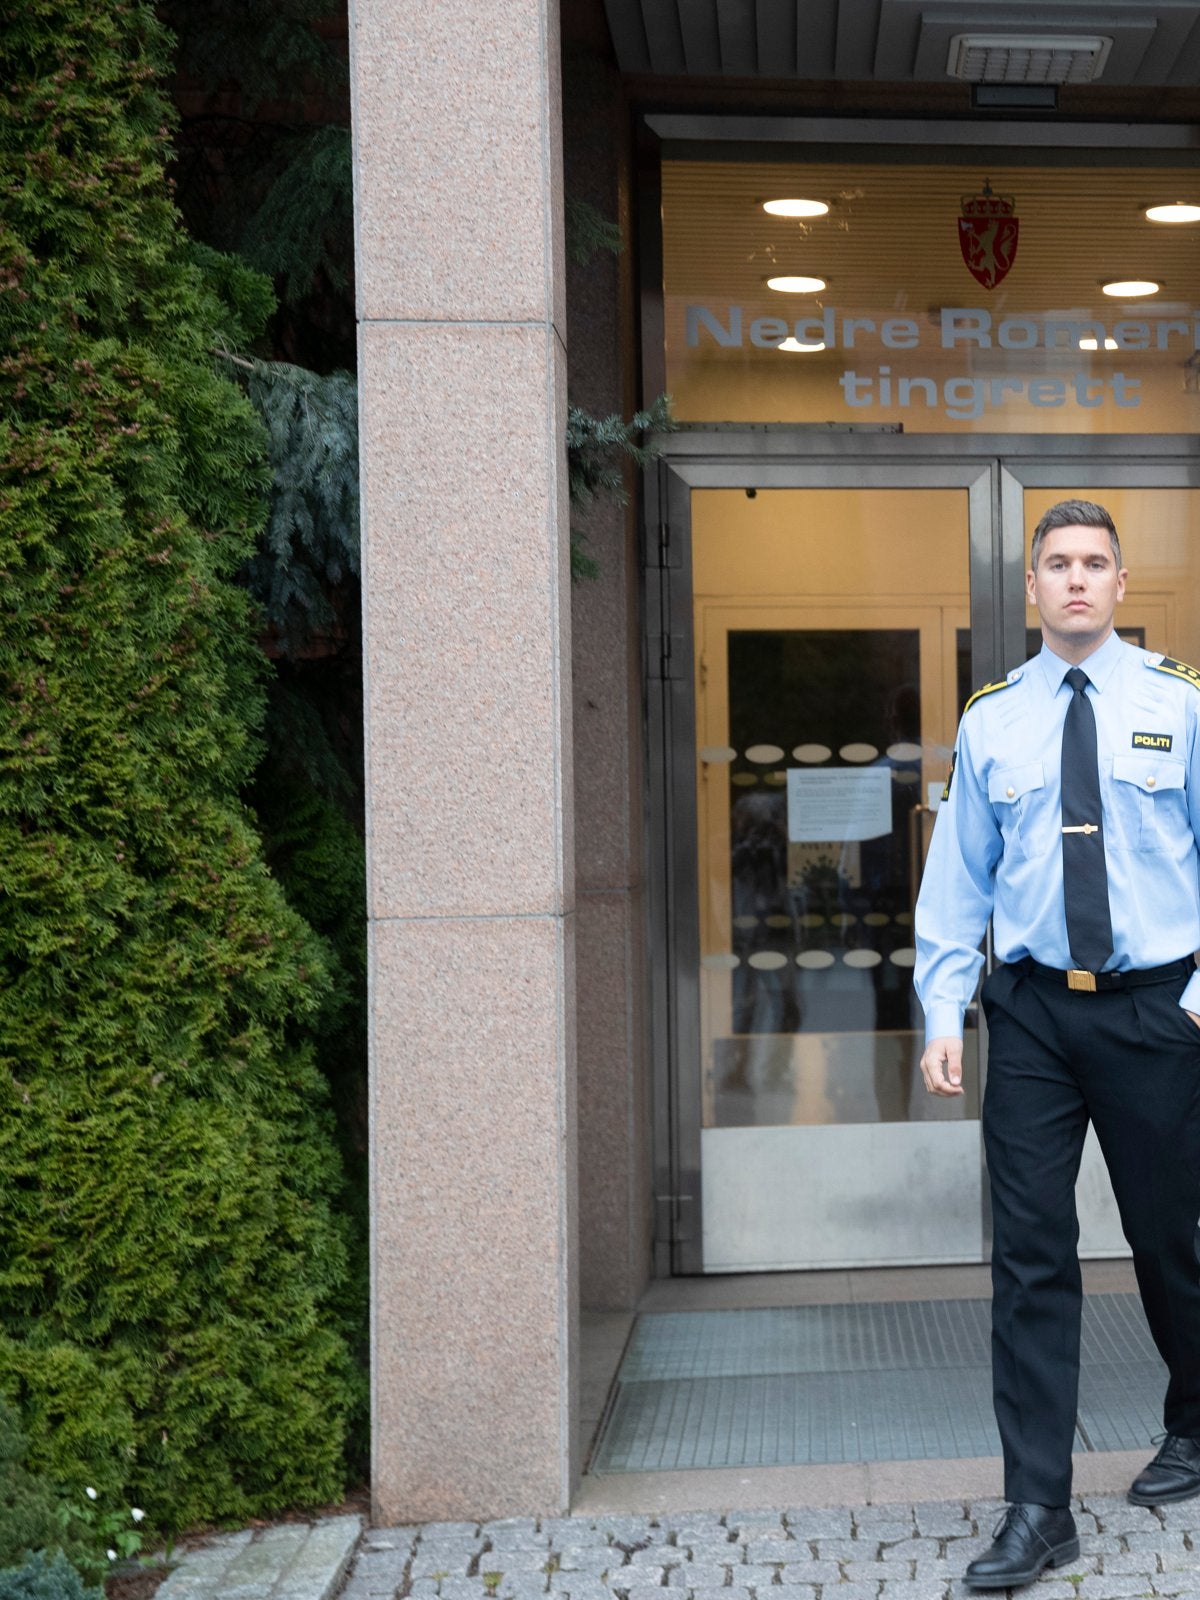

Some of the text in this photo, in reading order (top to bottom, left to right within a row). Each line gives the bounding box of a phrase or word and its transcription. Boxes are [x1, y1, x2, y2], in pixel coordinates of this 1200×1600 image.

[686, 305, 919, 349] Nedre
[839, 366, 1142, 420] tingrett
[1134, 735, 1170, 748] POLITI
